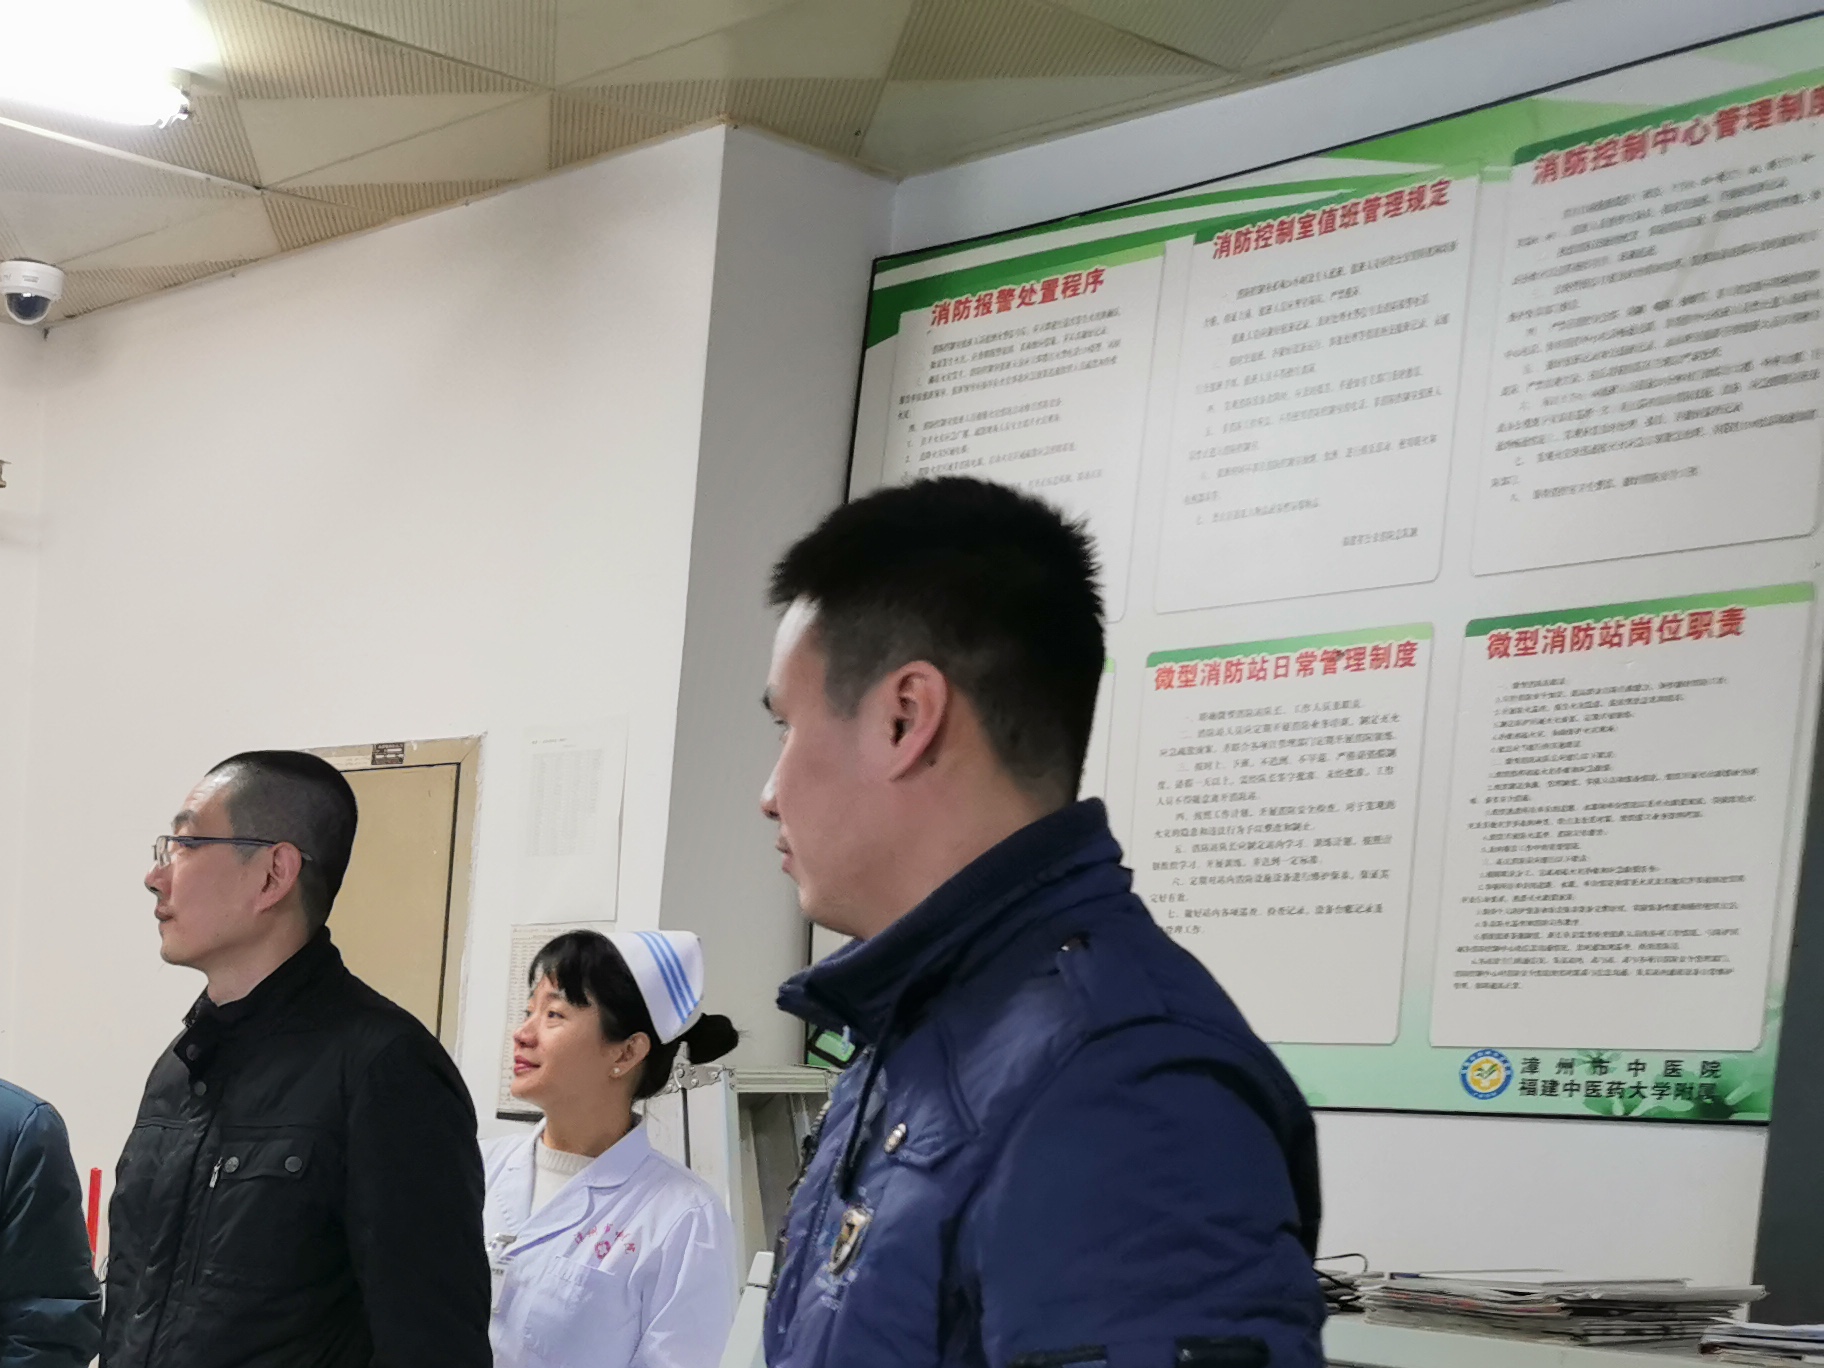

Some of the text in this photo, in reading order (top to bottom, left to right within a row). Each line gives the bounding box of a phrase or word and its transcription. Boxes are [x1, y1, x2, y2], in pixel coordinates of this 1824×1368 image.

[1212, 178, 1453, 260] 消防控制室值班管理规定
[930, 267, 1106, 327] 消防报警处置程序
[1486, 607, 1746, 660] 微型消防站岗位职责
[1154, 640, 1418, 691] 微型消防站日常管理制度
